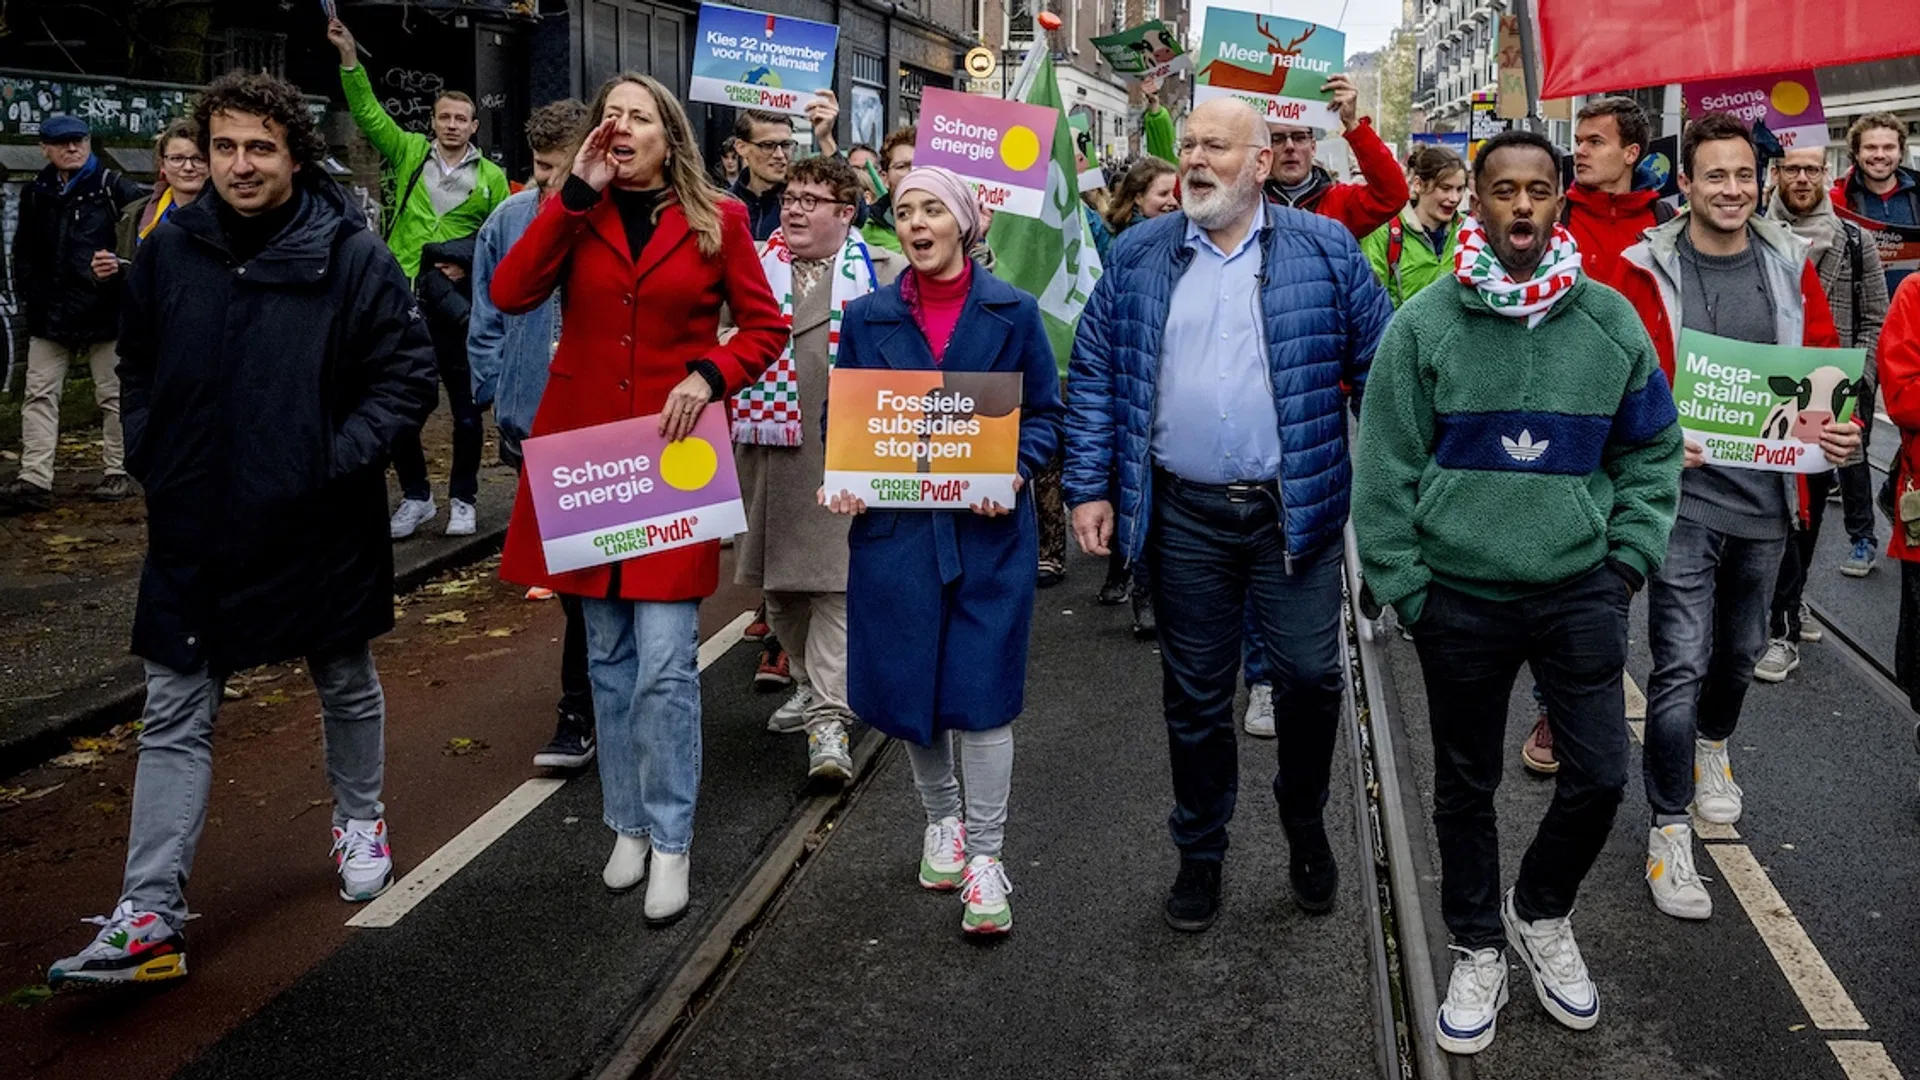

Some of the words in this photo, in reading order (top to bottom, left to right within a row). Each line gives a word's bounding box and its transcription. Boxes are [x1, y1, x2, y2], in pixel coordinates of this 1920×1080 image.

[706, 30, 738, 48] Kies
[740, 36, 758, 51] 22
[760, 40, 828, 61] november
[1218, 41, 1268, 64] Meer
[1270, 52, 1332, 73] natuur
[711, 46, 743, 61] voor
[744, 51, 769, 64] het
[771, 54, 819, 73] klimaat
[724, 85, 760, 96] GROEN
[729, 93, 760, 105] LINKS
[760, 90, 792, 109] PvdA
[1701, 90, 1766, 110] Schone
[1267, 99, 1300, 120] PvdA
[933, 115, 998, 141] Schone
[930, 137, 995, 161] energie
[977, 184, 1005, 205] PvdA
[1685, 352, 1761, 386] Mega-
[877, 390, 975, 413] Fossiele
[1693, 381, 1772, 407] stallen
[1678, 399, 1755, 426] sluiten
[867, 413, 981, 436] subsidies
[874, 438, 971, 463] stoppen
[1705, 438, 1756, 453] GROEN
[1712, 449, 1755, 462] LINKS
[1754, 444, 1796, 466] PvdA
[552, 454, 651, 488] Schone
[558, 475, 654, 511] energie
[870, 478, 921, 490] GROEN
[920, 480, 962, 502] PvdA
[879, 490, 920, 502] LINKS
[592, 526, 646, 549] GROEN
[645, 517, 694, 547] PvdA
[604, 539, 648, 557] LINKS
